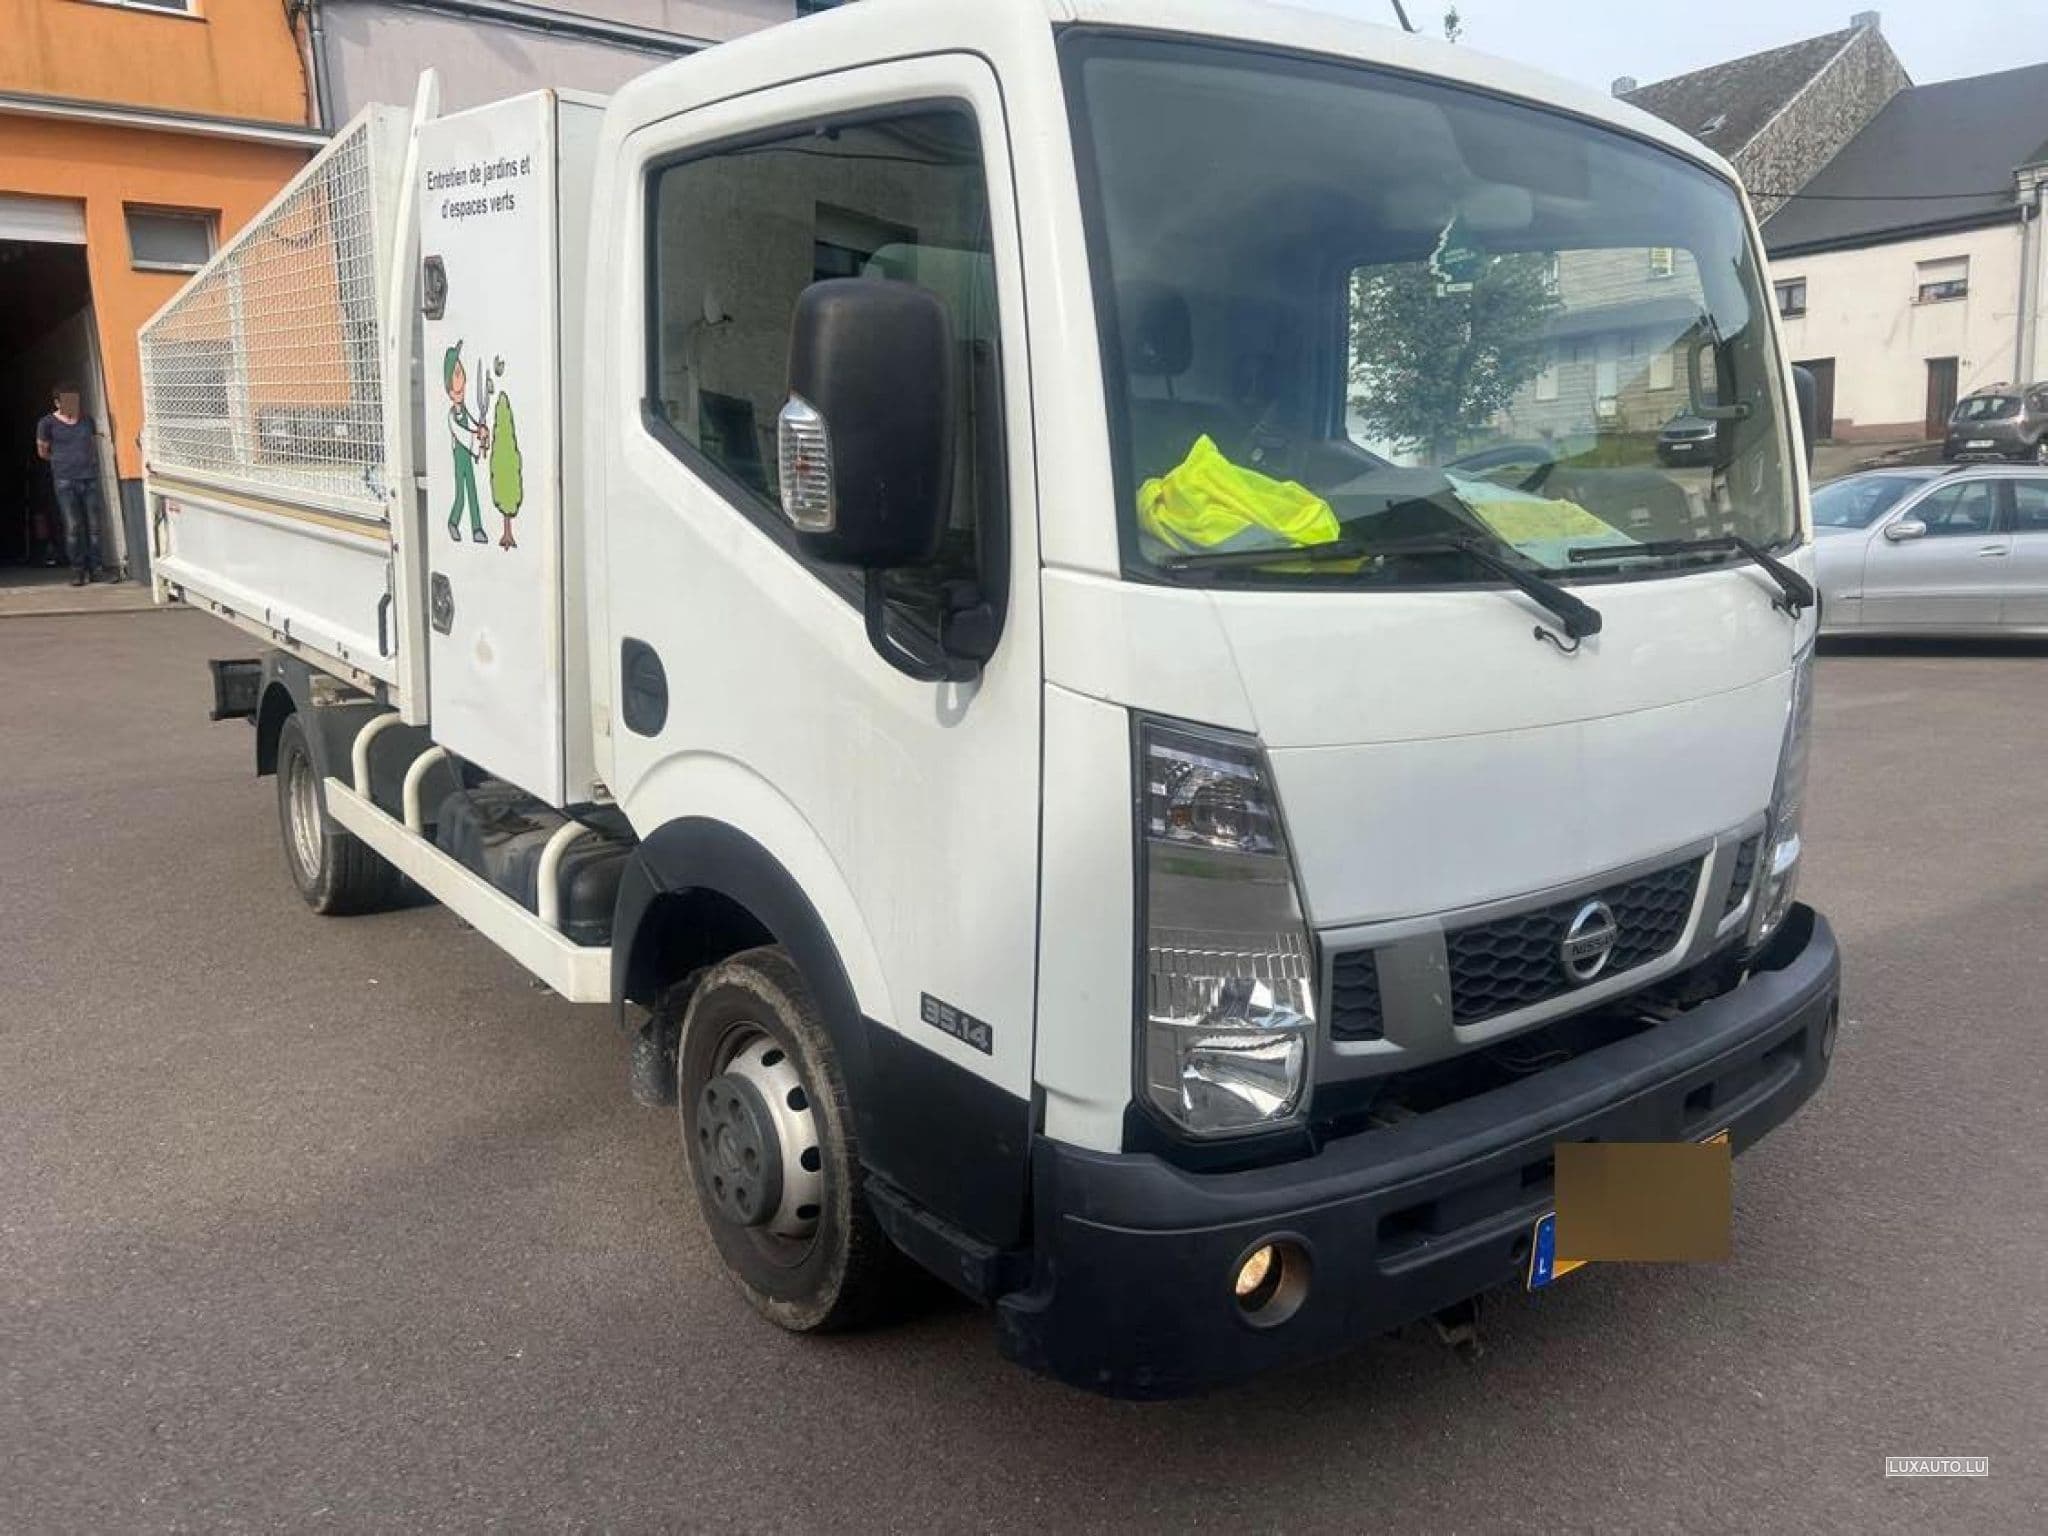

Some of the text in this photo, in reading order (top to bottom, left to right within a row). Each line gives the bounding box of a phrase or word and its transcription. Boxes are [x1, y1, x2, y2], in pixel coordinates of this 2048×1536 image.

[427, 154, 531, 190] Entretien de jardins et
[441, 188, 516, 221] d'espaces verts
